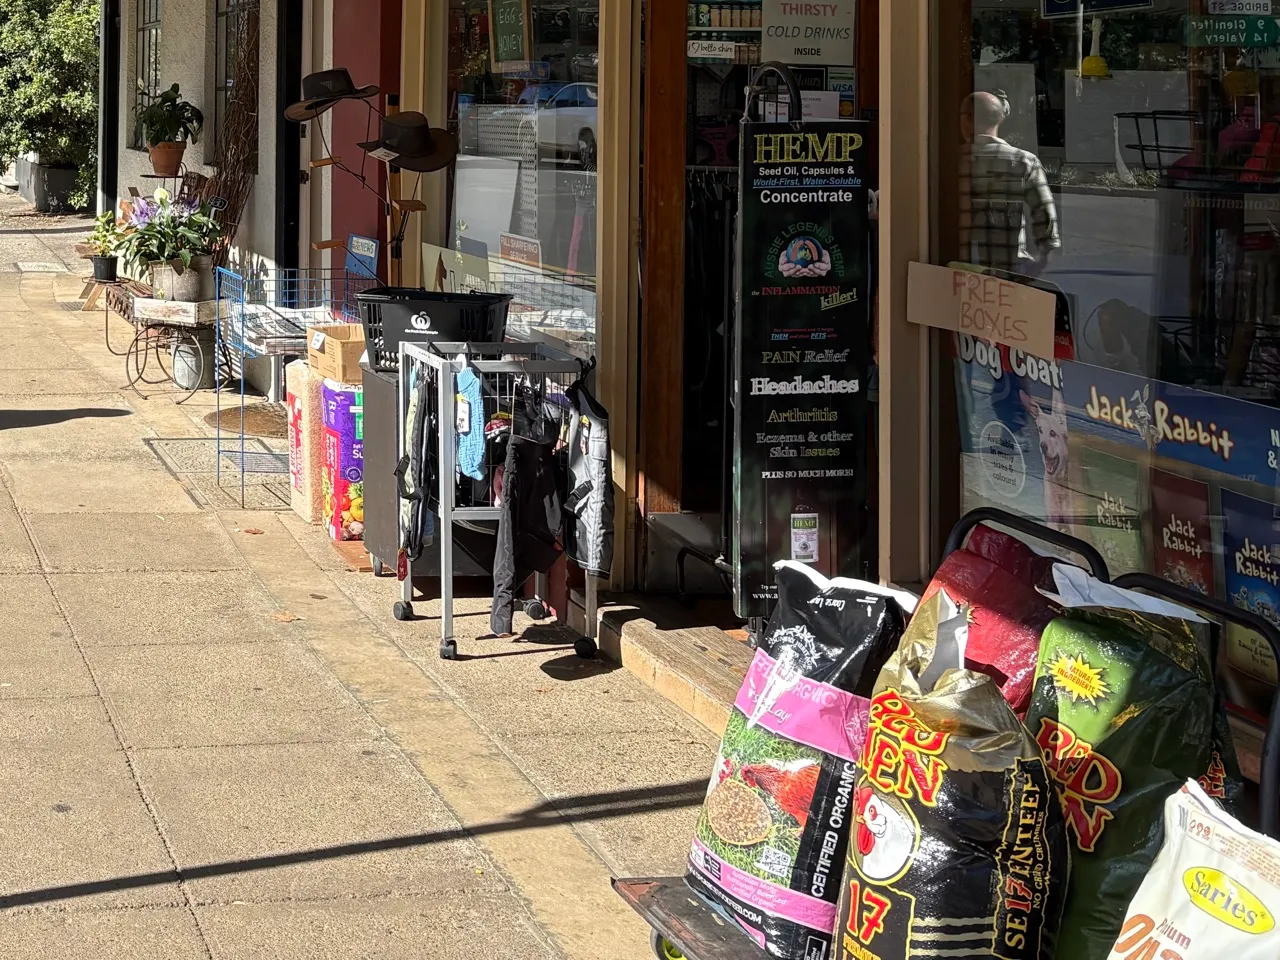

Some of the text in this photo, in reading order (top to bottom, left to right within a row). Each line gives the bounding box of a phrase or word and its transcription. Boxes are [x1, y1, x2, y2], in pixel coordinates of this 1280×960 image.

[500, 7, 524, 26] EGGS
[781, 2, 838, 17] THIRSTY
[767, 25, 851, 40] COLD DRINKS
[499, 34, 522, 52] HONEY
[700, 43, 716, 53] bello
[718, 43, 734, 53] shire
[794, 47, 822, 57] INSIDE
[832, 83, 853, 93] VISA
[753, 132, 863, 164] HEMP
[759, 166, 855, 177] Seed Oil, Capsules &
[753, 177, 861, 187] World-First, Water-Soluble
[760, 189, 853, 204] Concentrate
[764, 222, 845, 278] AUSSIE LEGENDS HEMP
[761, 286, 841, 296] INFLAMMATION
[820, 288, 858, 310] killer!
[952, 271, 1016, 308] FREE
[961, 303, 1028, 341] BOXES
[811, 332, 827, 340] PETS
[762, 349, 850, 364] PAIN Relief
[958, 332, 1003, 380] Dog
[750, 375, 859, 396] Headaches
[766, 408, 838, 423] Arthritis
[1086, 386, 1235, 460] Jack Rabbit
[756, 430, 853, 444] Eczema & other
[770, 445, 840, 458] Skin Issues
[761, 468, 854, 479] PLUS SO MUCH MORE!
[1102, 492, 1127, 515] Jack
[794, 520, 816, 528] HEMP
[1097, 504, 1133, 534] Rabbit
[1168, 515, 1196, 539] Jack
[1163, 526, 1203, 560] Rabbit
[1241, 538, 1272, 563] Jack
[1235, 550, 1280, 586] Rabbit
[1057, 667, 1096, 693] INGREDIENTS
[1035, 717, 1122, 804] RED
[811, 762, 857, 898] CETIFIED ORGANIC
[1034, 810, 1045, 861] CRUMBLES
[1033, 893, 1042, 909] NO
[847, 880, 891, 945] 17
